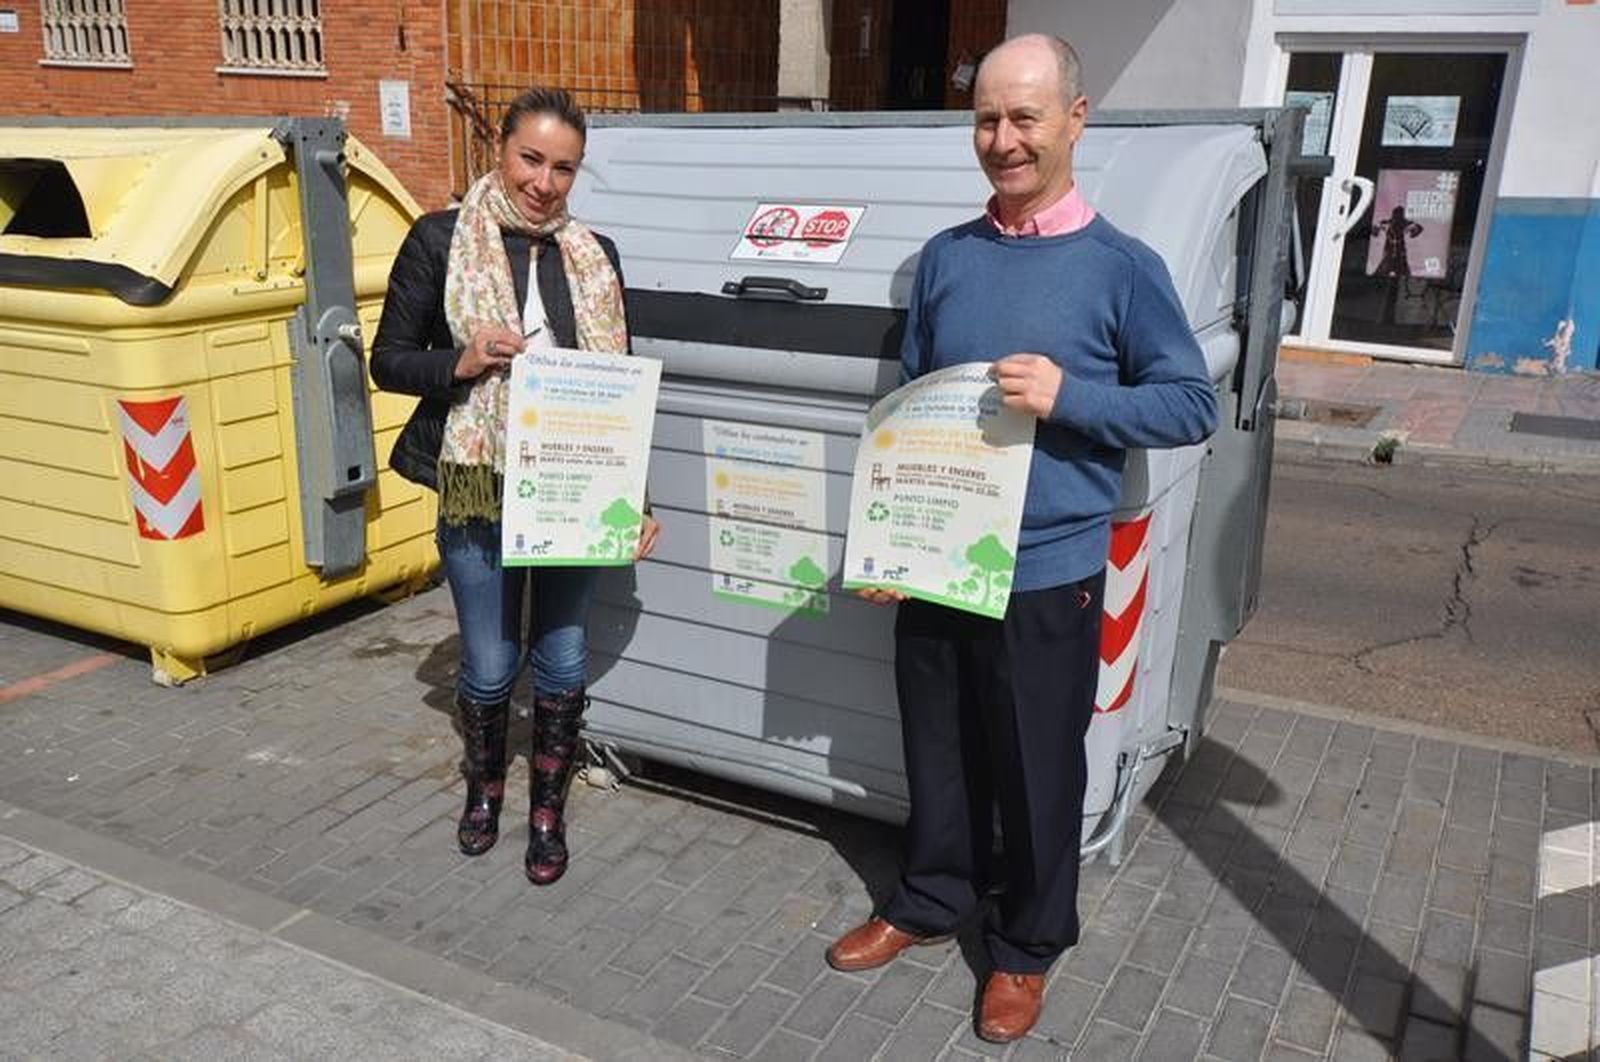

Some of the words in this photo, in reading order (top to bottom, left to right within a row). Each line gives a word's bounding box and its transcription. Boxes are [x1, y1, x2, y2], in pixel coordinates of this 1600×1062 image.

[805, 219, 849, 235] STOP
[896, 462, 937, 474] MUEBLES
[940, 464, 947, 474] Y
[949, 465, 987, 482] ENSERES
[894, 493, 924, 505] PUNTO
[927, 497, 960, 510] LIMPIO
